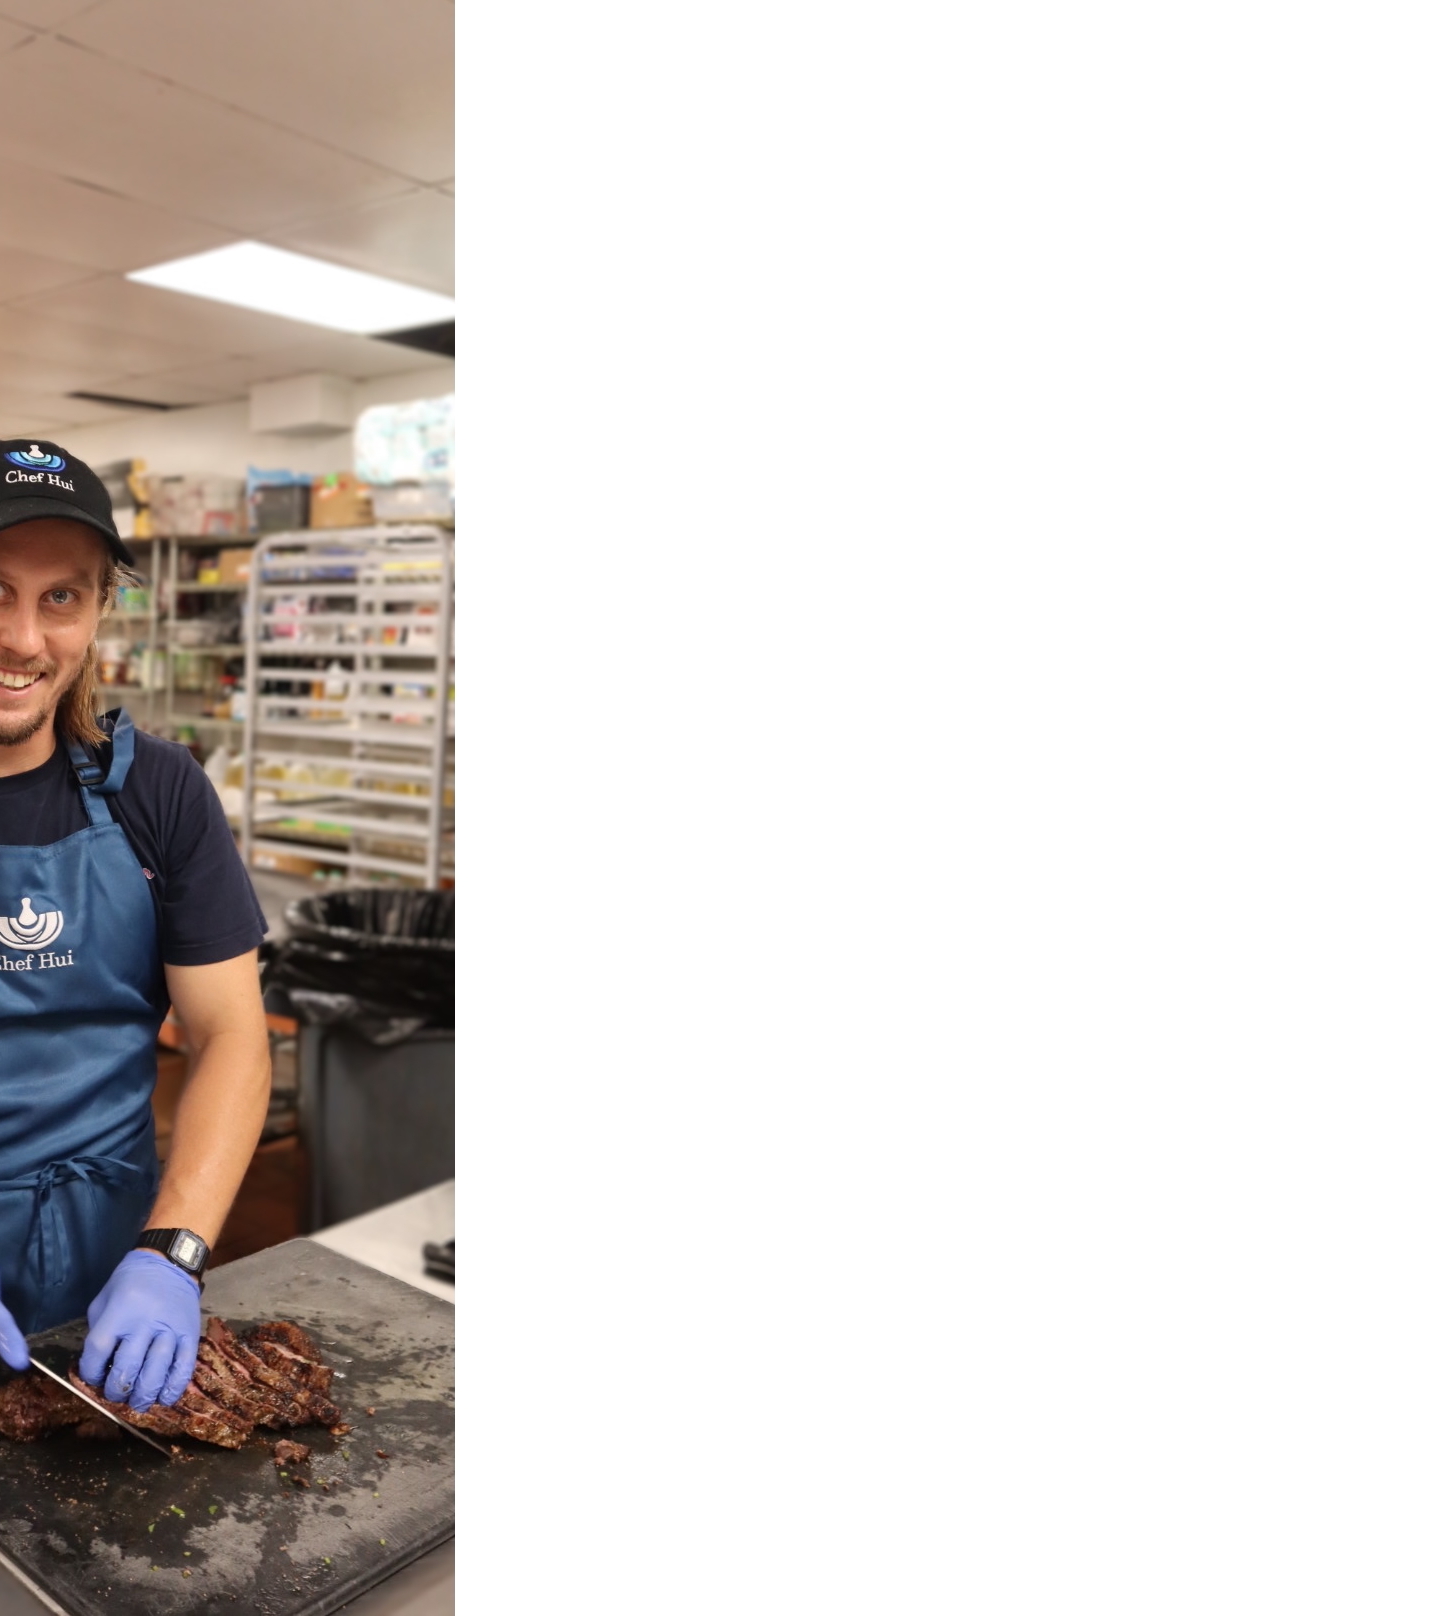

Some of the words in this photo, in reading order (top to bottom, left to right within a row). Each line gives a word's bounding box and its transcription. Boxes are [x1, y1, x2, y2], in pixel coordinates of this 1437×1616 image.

[5, 470, 44, 483] Chef
[47, 473, 75, 492] Hui
[38, 950, 74, 969] Hui
